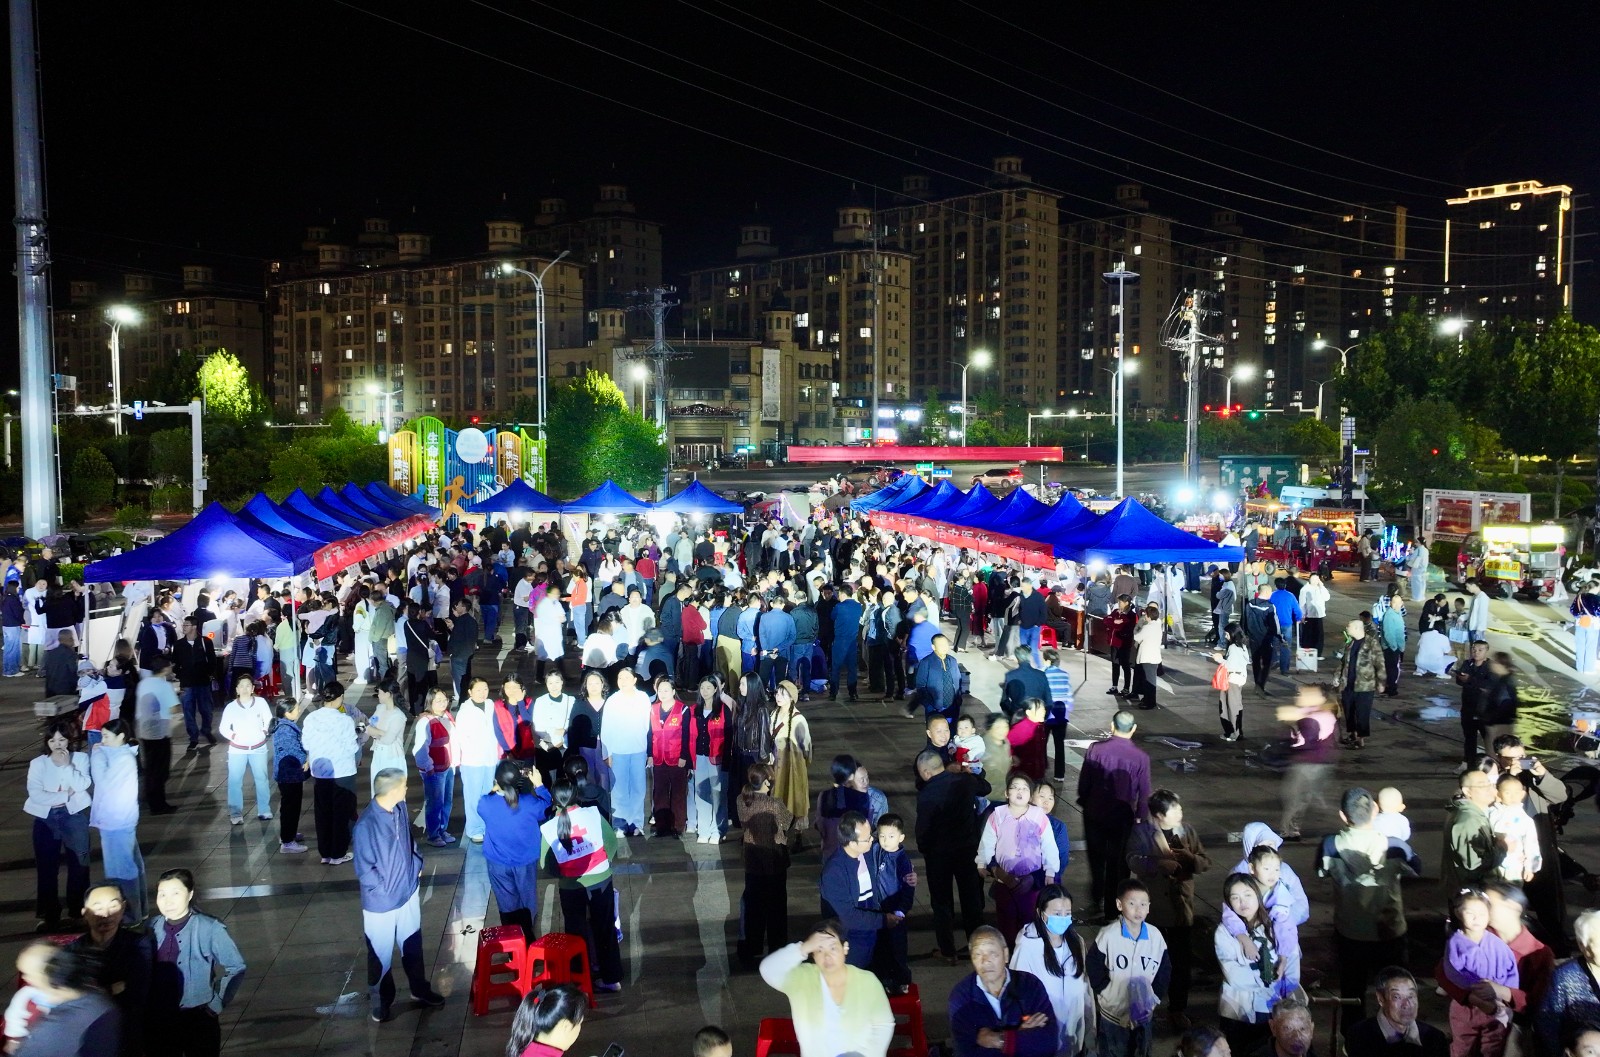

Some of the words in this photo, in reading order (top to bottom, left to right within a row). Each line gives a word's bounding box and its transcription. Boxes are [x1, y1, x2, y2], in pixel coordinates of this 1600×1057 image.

[426, 431, 439, 508] 生命在于运动
